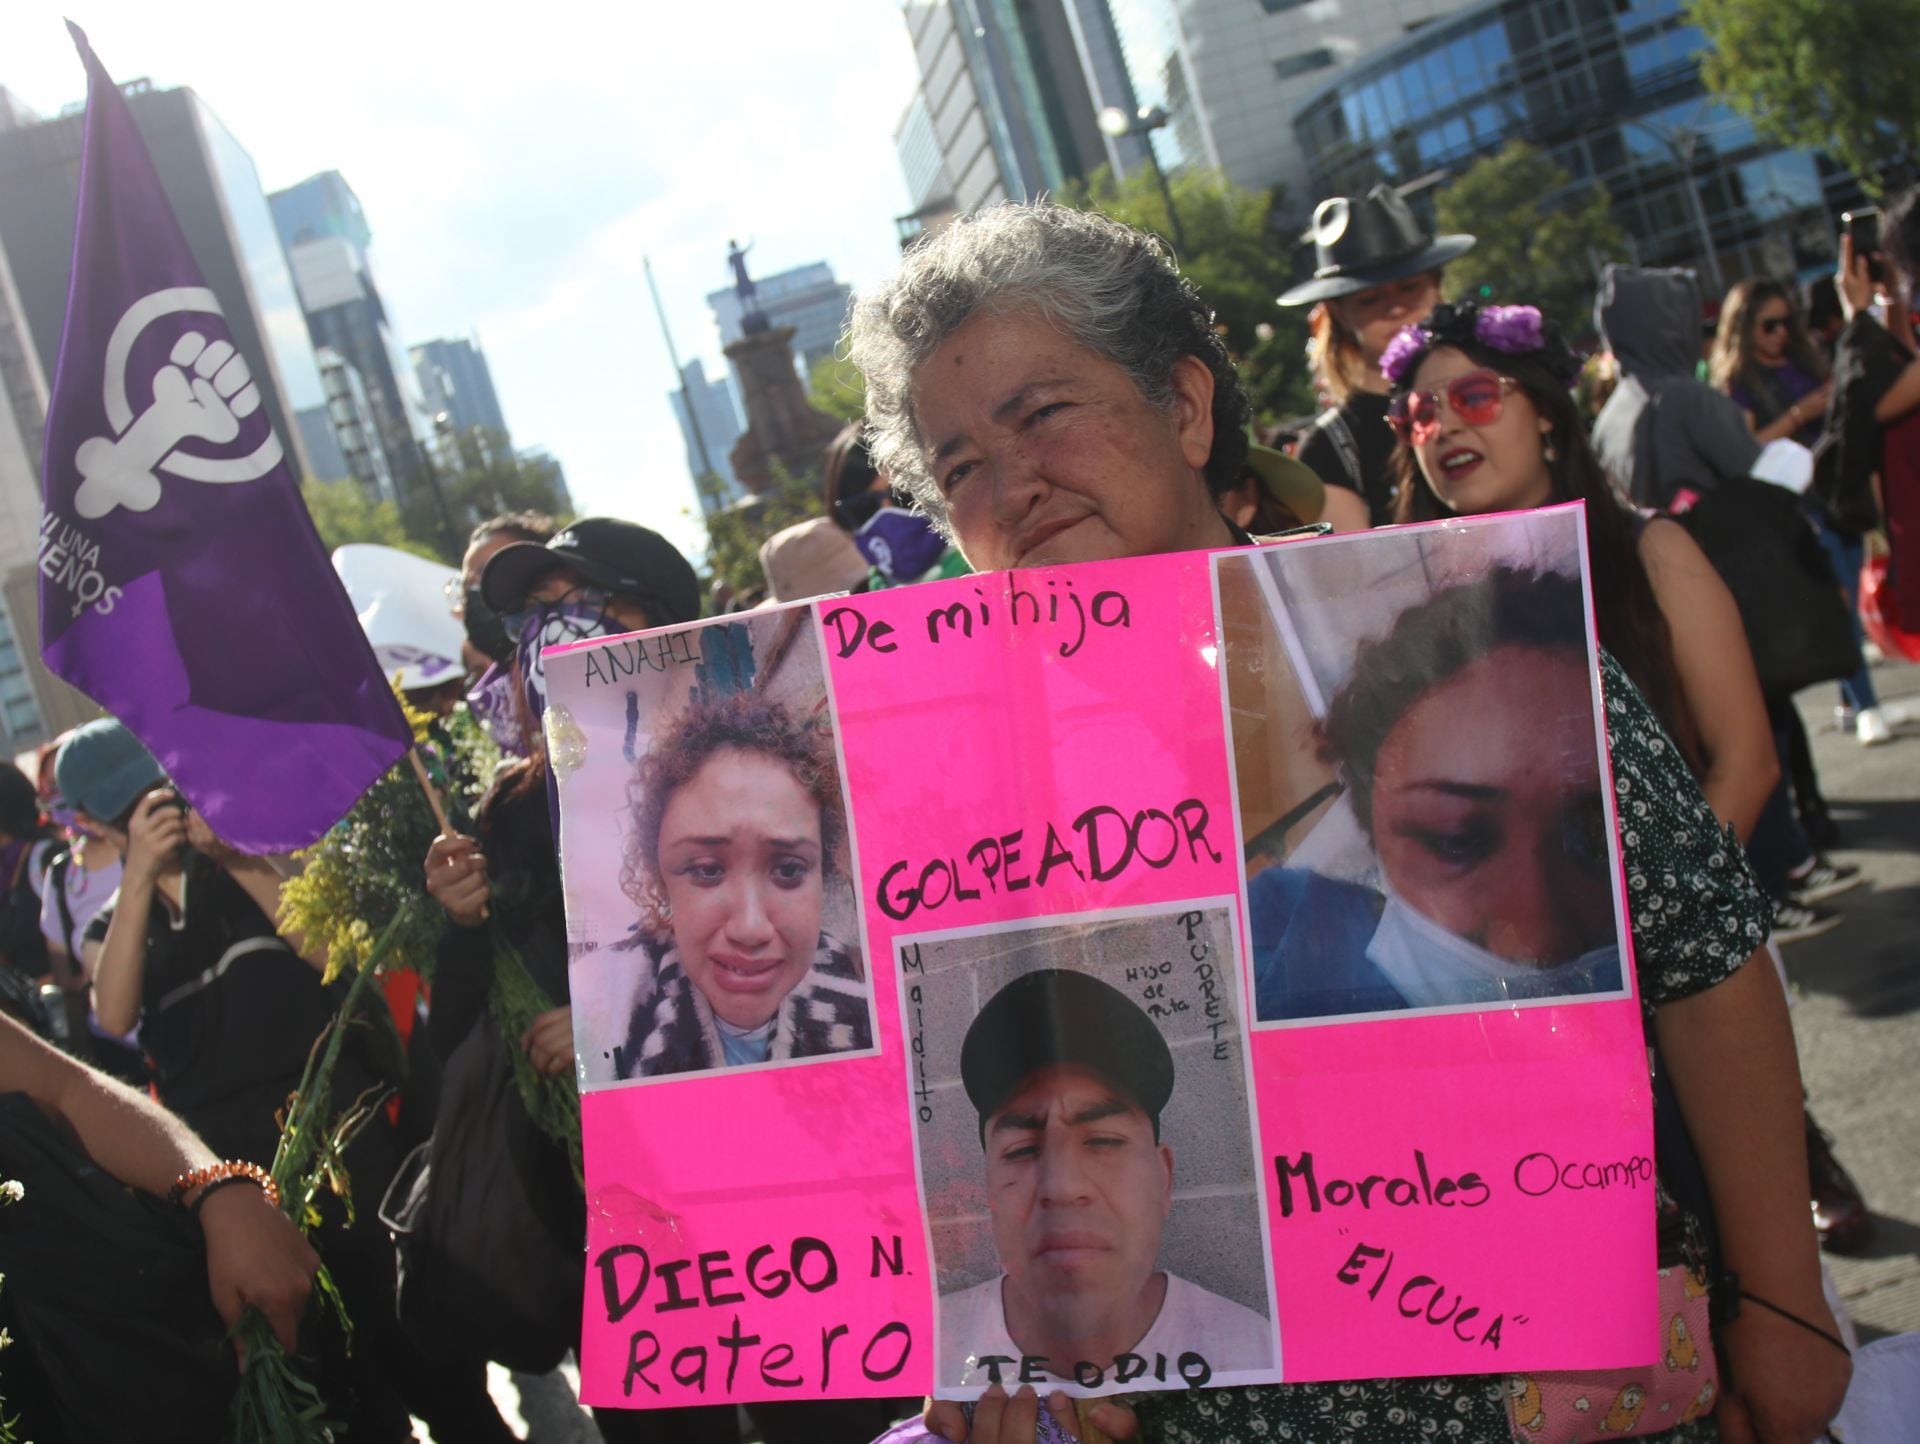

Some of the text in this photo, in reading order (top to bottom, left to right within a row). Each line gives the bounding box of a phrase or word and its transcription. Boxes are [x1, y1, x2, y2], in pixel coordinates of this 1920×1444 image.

[59, 524, 100, 568] UNA
[823, 571, 1131, 659] De mi hija
[585, 630, 702, 688] ANAHI
[876, 798, 1222, 921] GOLPEADOR
[1143, 983, 1165, 999] de
[1177, 910, 1230, 1061] PUDRETE
[900, 942, 934, 1123] Maldito
[1274, 1149, 1653, 1217] Morales Ocampo
[594, 1235, 914, 1323] DIEGO N.
[622, 1314, 913, 1397] Ratero
[977, 1351, 1212, 1389] TE ODIO
